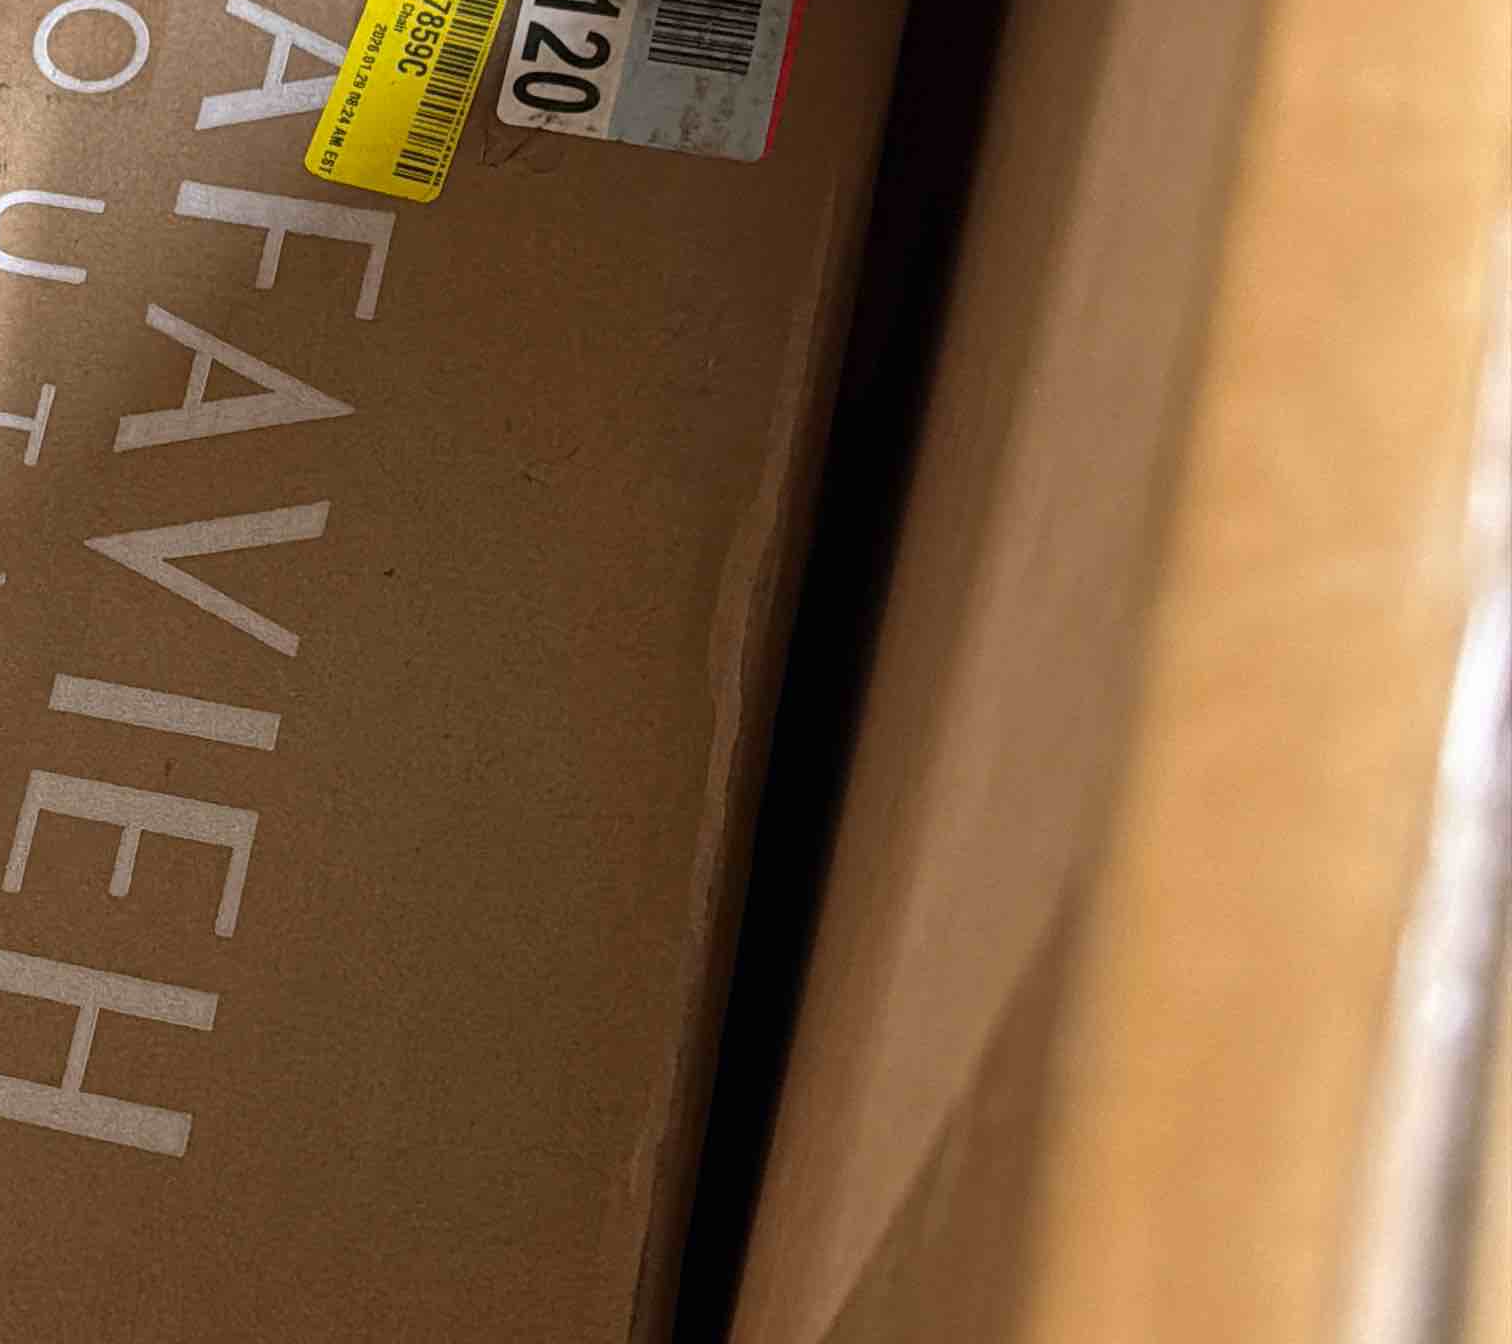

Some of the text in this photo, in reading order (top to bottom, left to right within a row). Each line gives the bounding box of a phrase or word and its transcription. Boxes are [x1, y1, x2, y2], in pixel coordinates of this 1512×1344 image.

[392, 1, 414, 34] Chair
[327, 125, 346, 148] AM
[317, 148, 338, 175] EST
